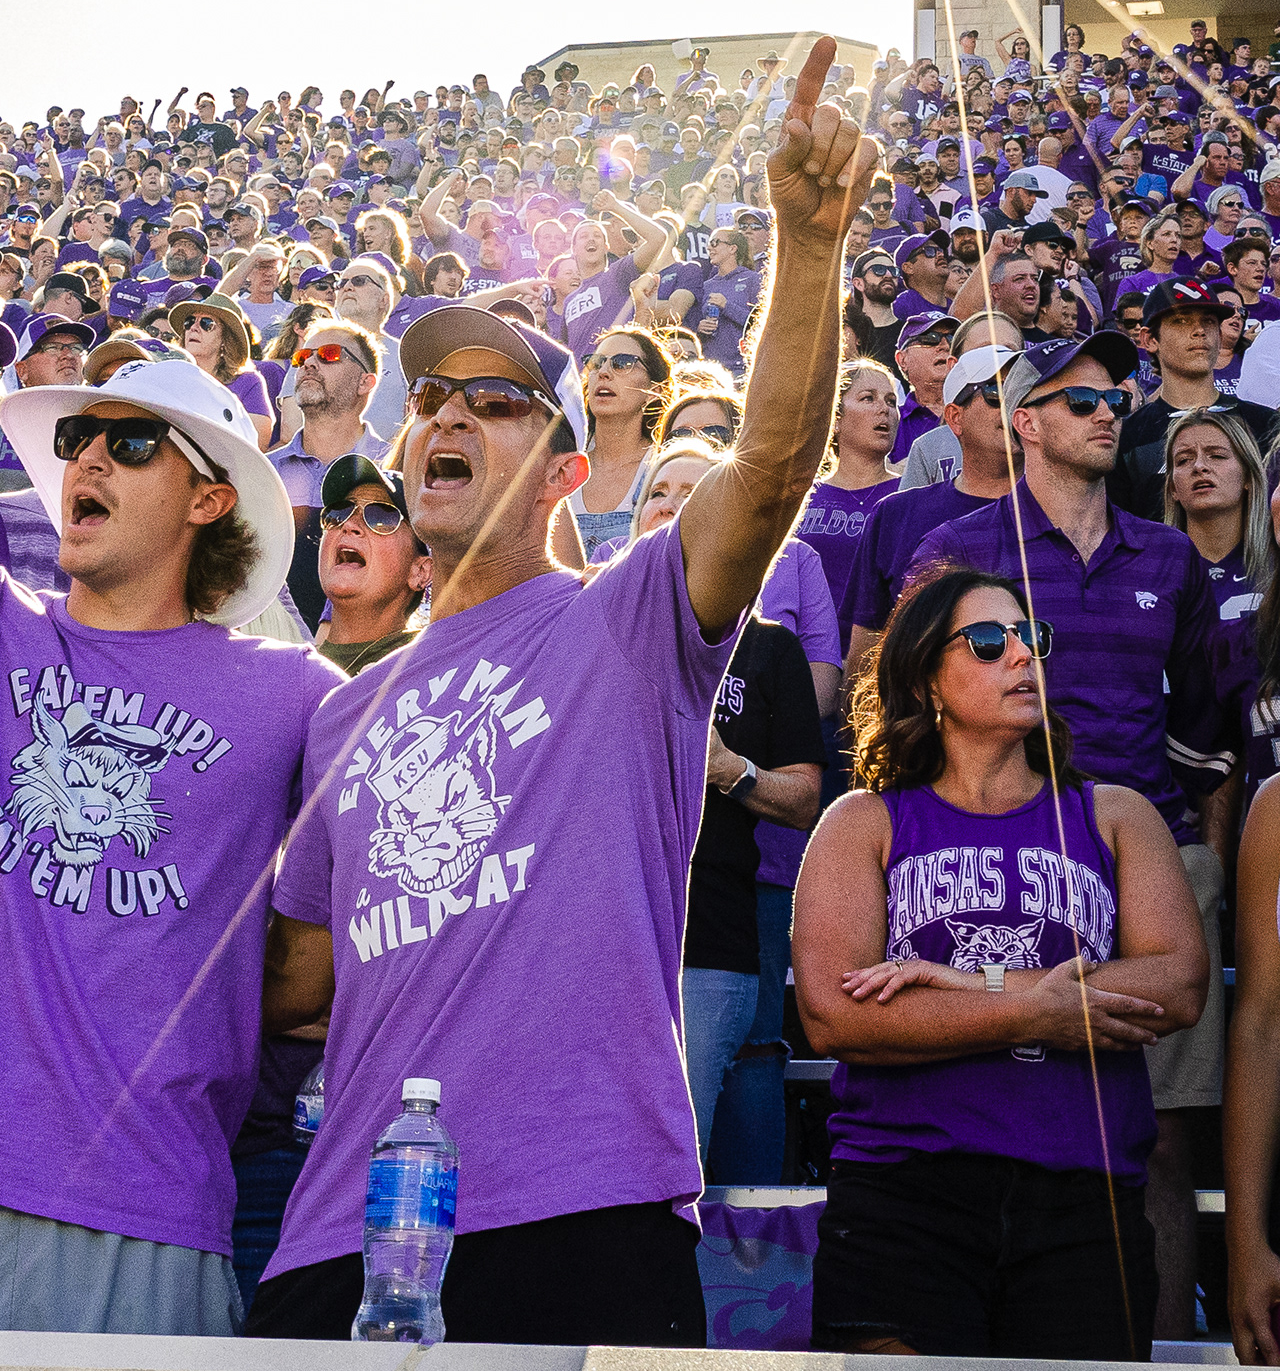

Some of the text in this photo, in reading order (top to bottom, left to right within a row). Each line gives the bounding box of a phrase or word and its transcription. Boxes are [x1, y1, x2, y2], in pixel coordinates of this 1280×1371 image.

[1111, 247, 1142, 264] K-STA
[463, 279, 502, 292] K-STA
[8, 664, 75, 717] EAT
[160, 703, 234, 774] UP!
[338, 657, 552, 816] EVERY MAN
[392, 748, 431, 789] KSU
[106, 863, 191, 916] UP!
[1018, 847, 1117, 963] STATE
